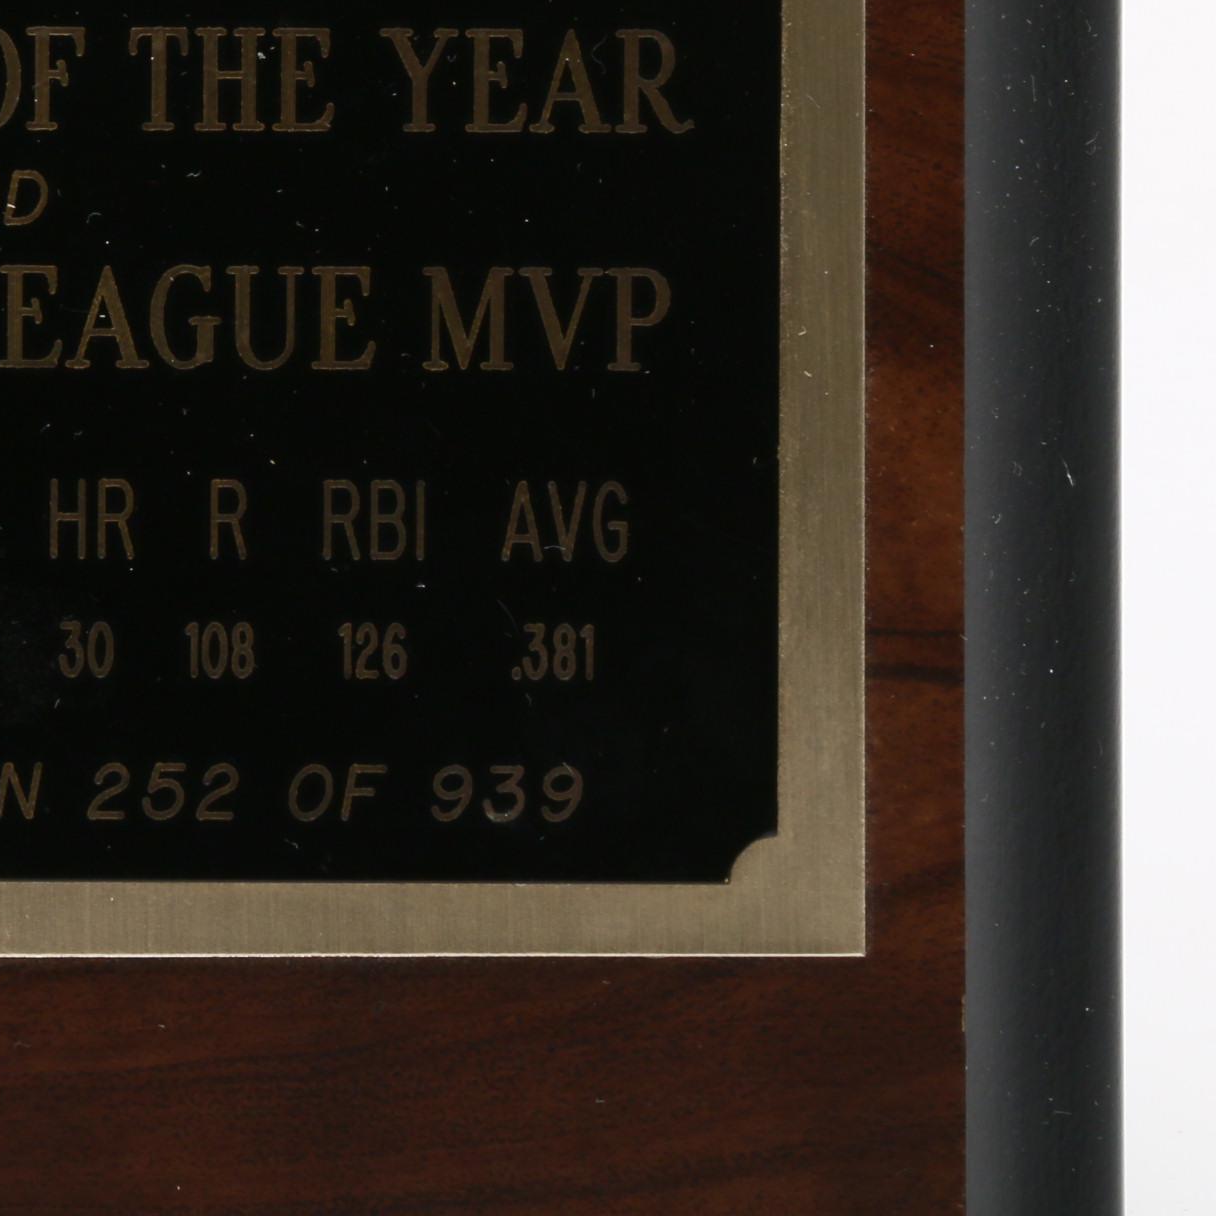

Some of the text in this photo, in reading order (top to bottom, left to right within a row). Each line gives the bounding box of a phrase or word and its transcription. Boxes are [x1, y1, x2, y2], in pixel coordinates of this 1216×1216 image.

[128, 25, 334, 133] THE
[379, 27, 695, 134] YEAR
[422, 266, 671, 372] MVP
[49, 477, 135, 560] HR
[209, 478, 247, 560] R
[322, 479, 426, 561] RBI
[501, 480, 629, 563] AVG
[58, 620, 114, 679] 30
[184, 621, 257, 679] 108
[338, 622, 408, 680] 126
[510, 622, 595, 682] .381
[86, 761, 239, 821] 252
[288, 763, 388, 822] OF
[431, 762, 584, 824] 939
